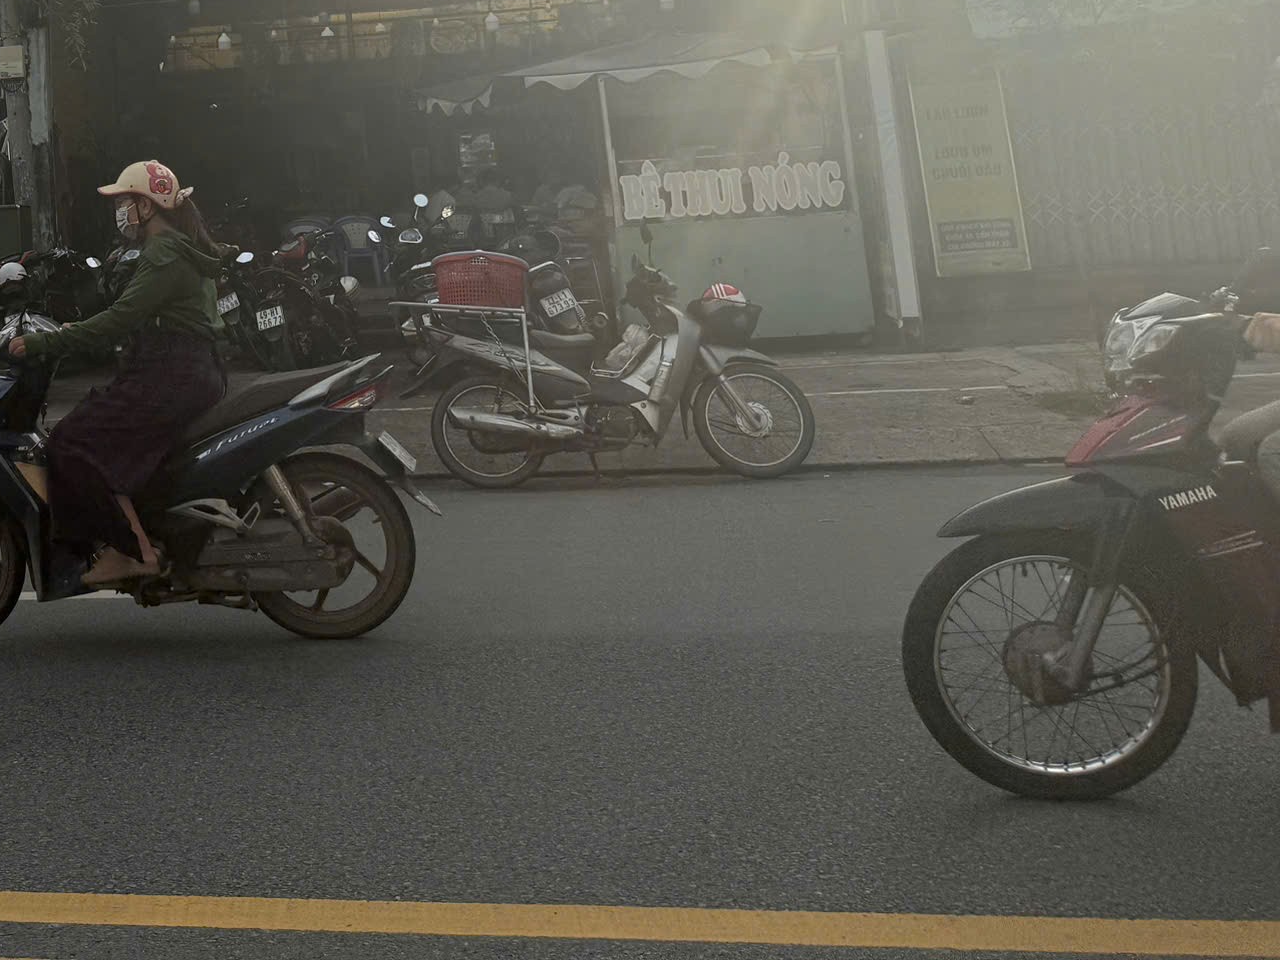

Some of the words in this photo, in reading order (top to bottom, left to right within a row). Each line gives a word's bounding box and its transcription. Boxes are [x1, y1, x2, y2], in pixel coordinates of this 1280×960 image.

[619, 159, 666, 221] BÊ
[664, 168, 747, 217] THUI
[748, 151, 845, 213] NÓNG
[1158, 484, 1218, 511] YAMAHA
